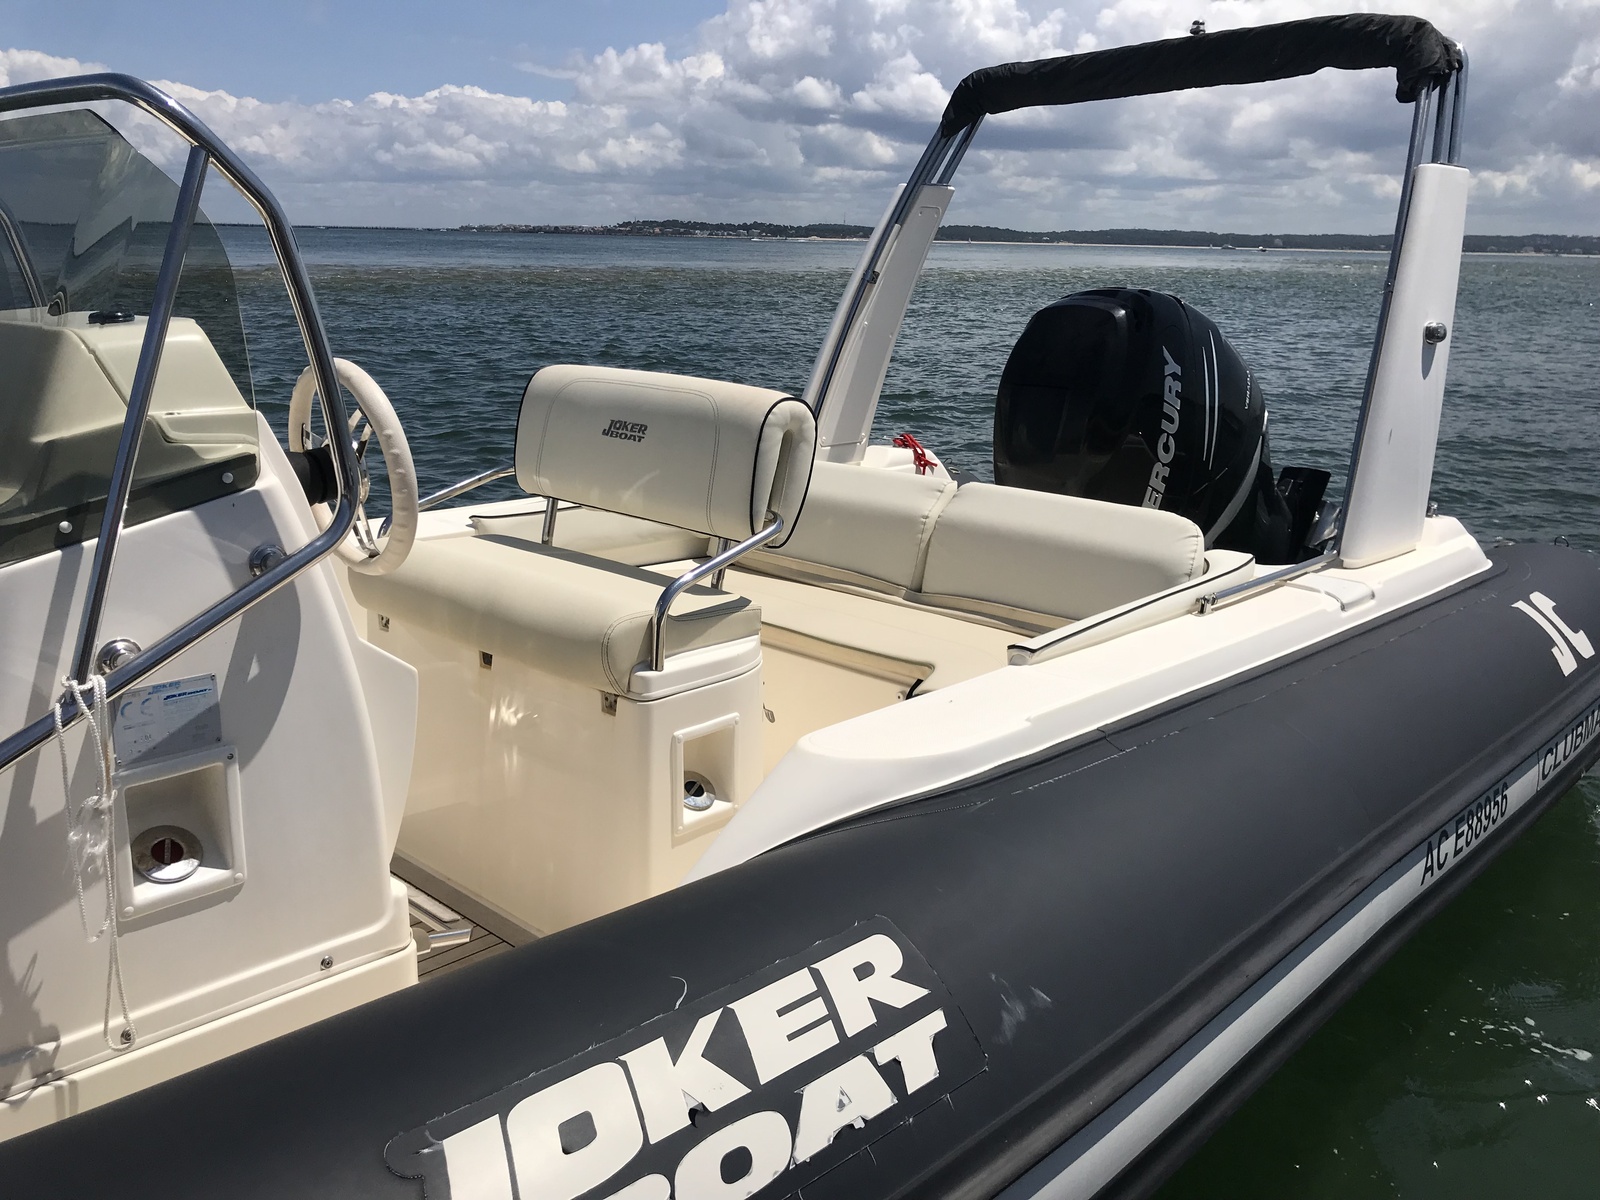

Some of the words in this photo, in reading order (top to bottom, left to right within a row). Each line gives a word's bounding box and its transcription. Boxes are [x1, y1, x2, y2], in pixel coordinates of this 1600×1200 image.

[602, 419, 648, 436] JOKER
[609, 430, 645, 442] BOAT
[1141, 345, 1182, 511] ERCURY
[1419, 829, 1449, 887] AC
[1453, 782, 1509, 859] E88956
